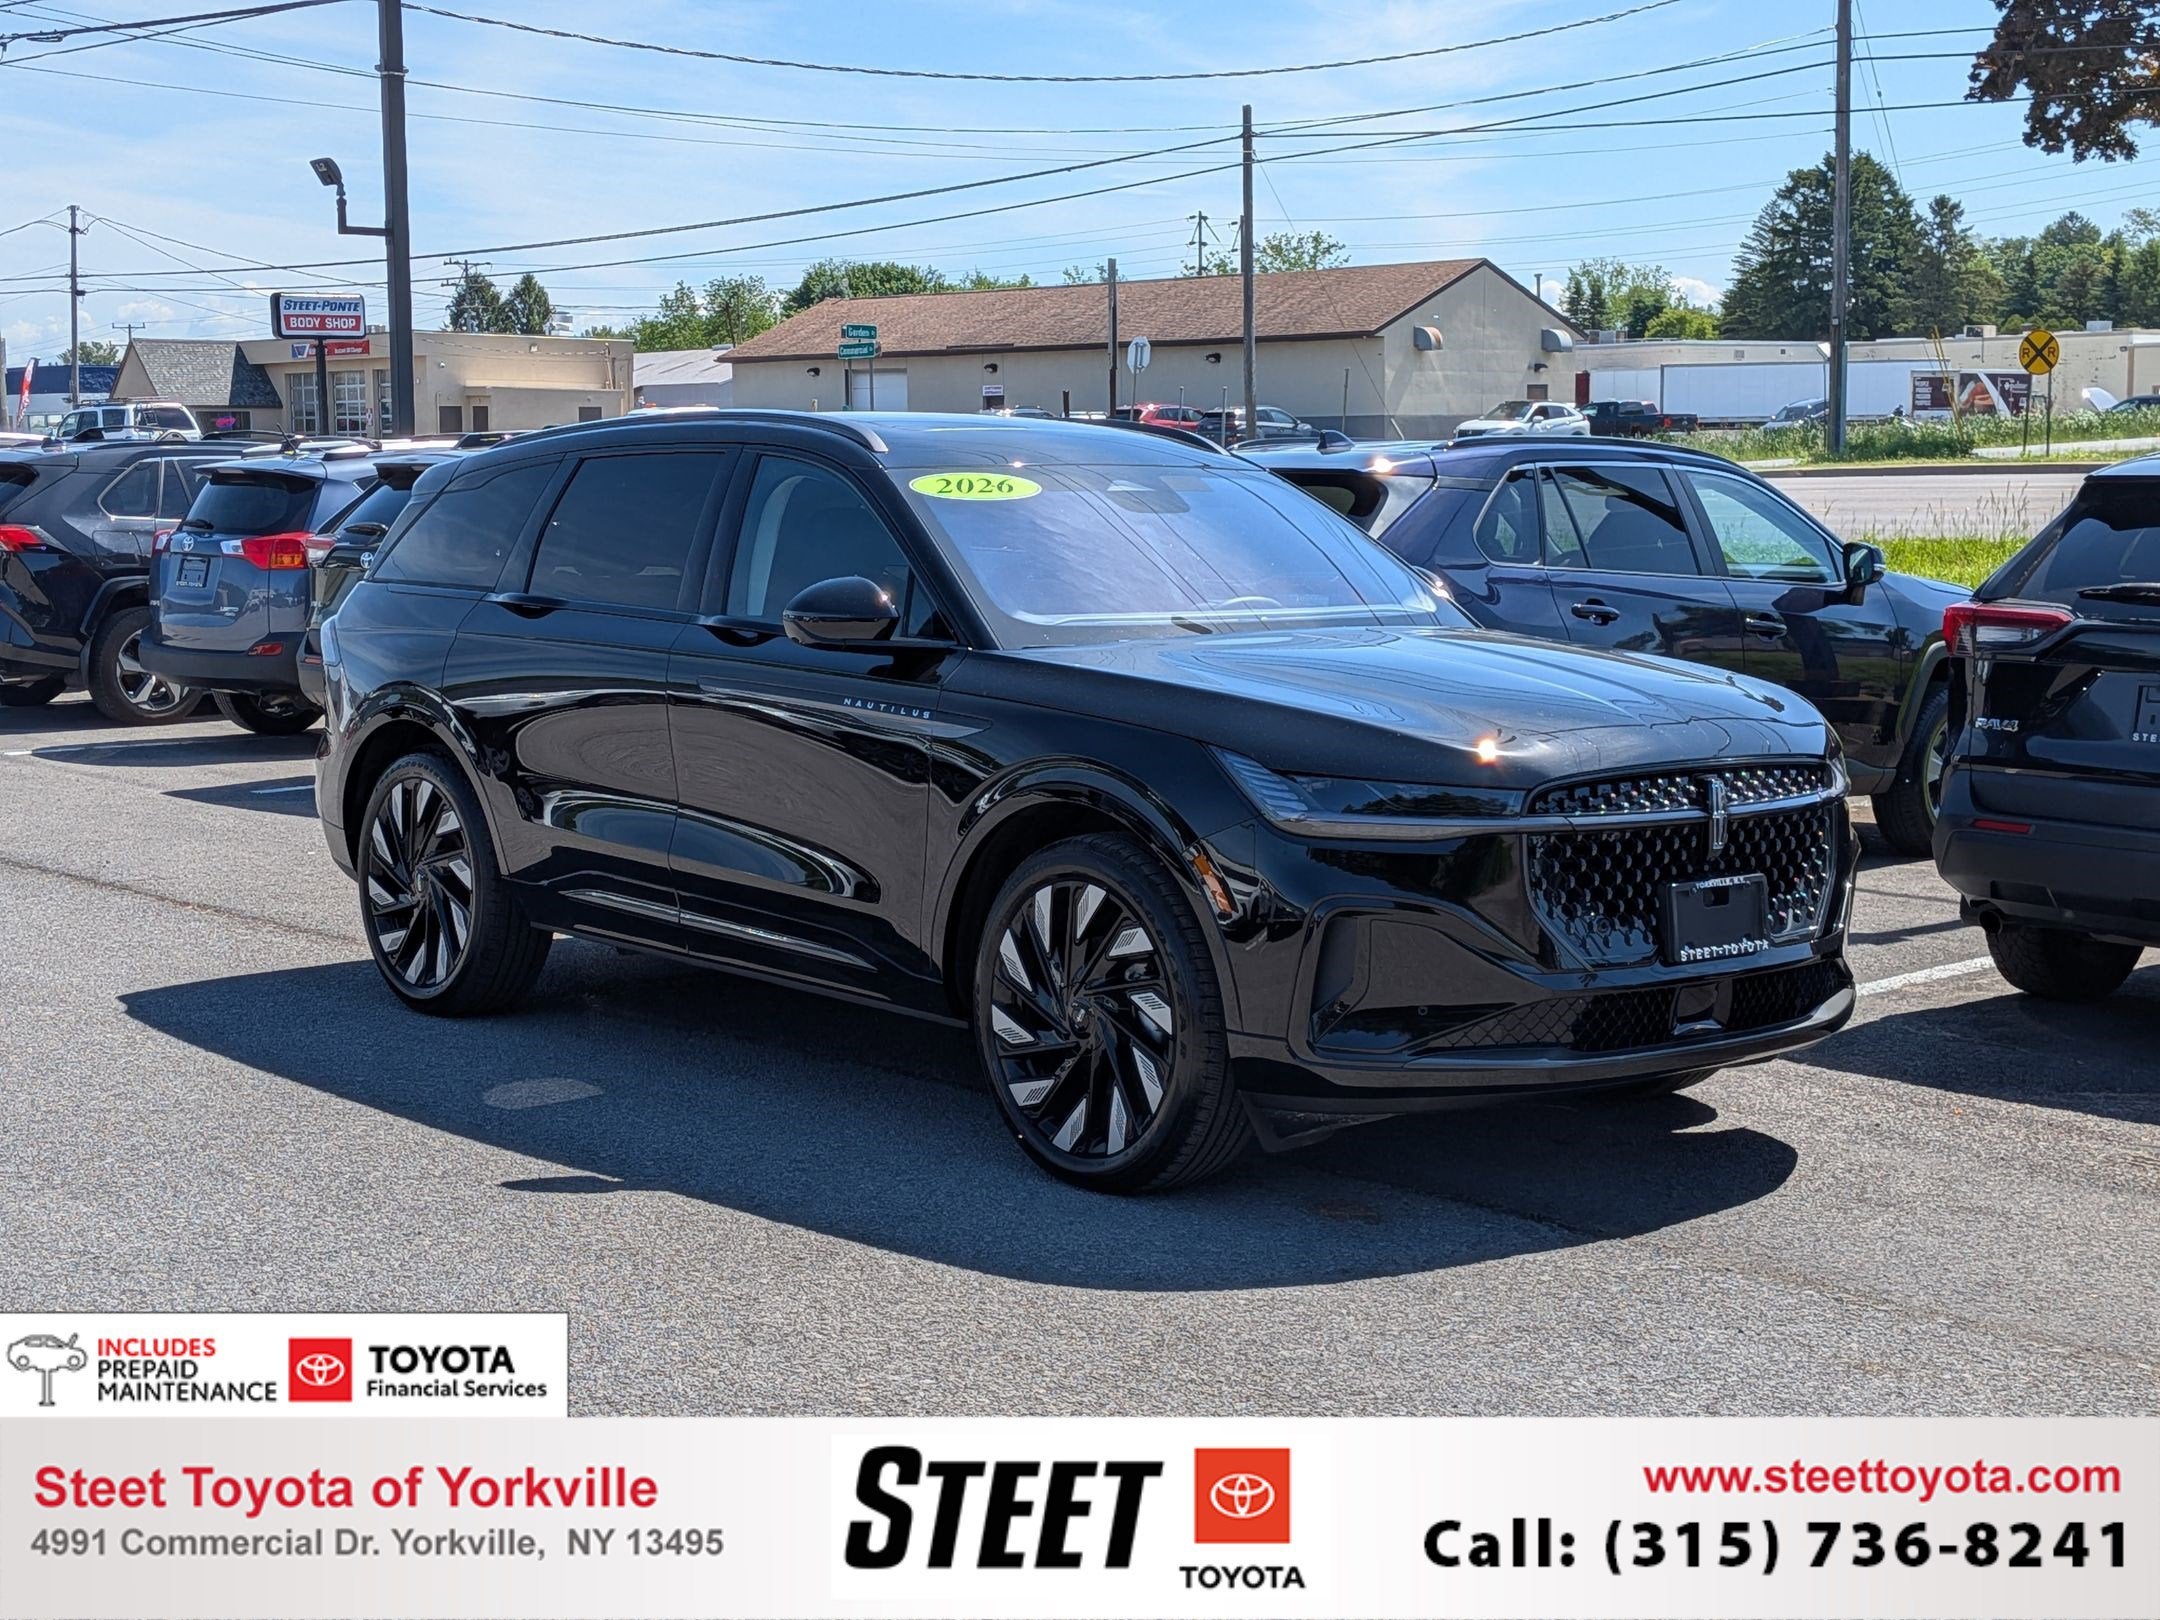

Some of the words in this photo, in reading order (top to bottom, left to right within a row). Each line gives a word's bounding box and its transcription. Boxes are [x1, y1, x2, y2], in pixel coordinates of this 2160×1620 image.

[289, 317, 320, 328] BODY
[325, 318, 356, 329] SHOP
[935, 478, 1014, 494] 2026
[843, 697, 931, 719] NAUTILUS
[2132, 732, 2160, 743] STE
[1680, 938, 1769, 962] STEET-TOYOTA
